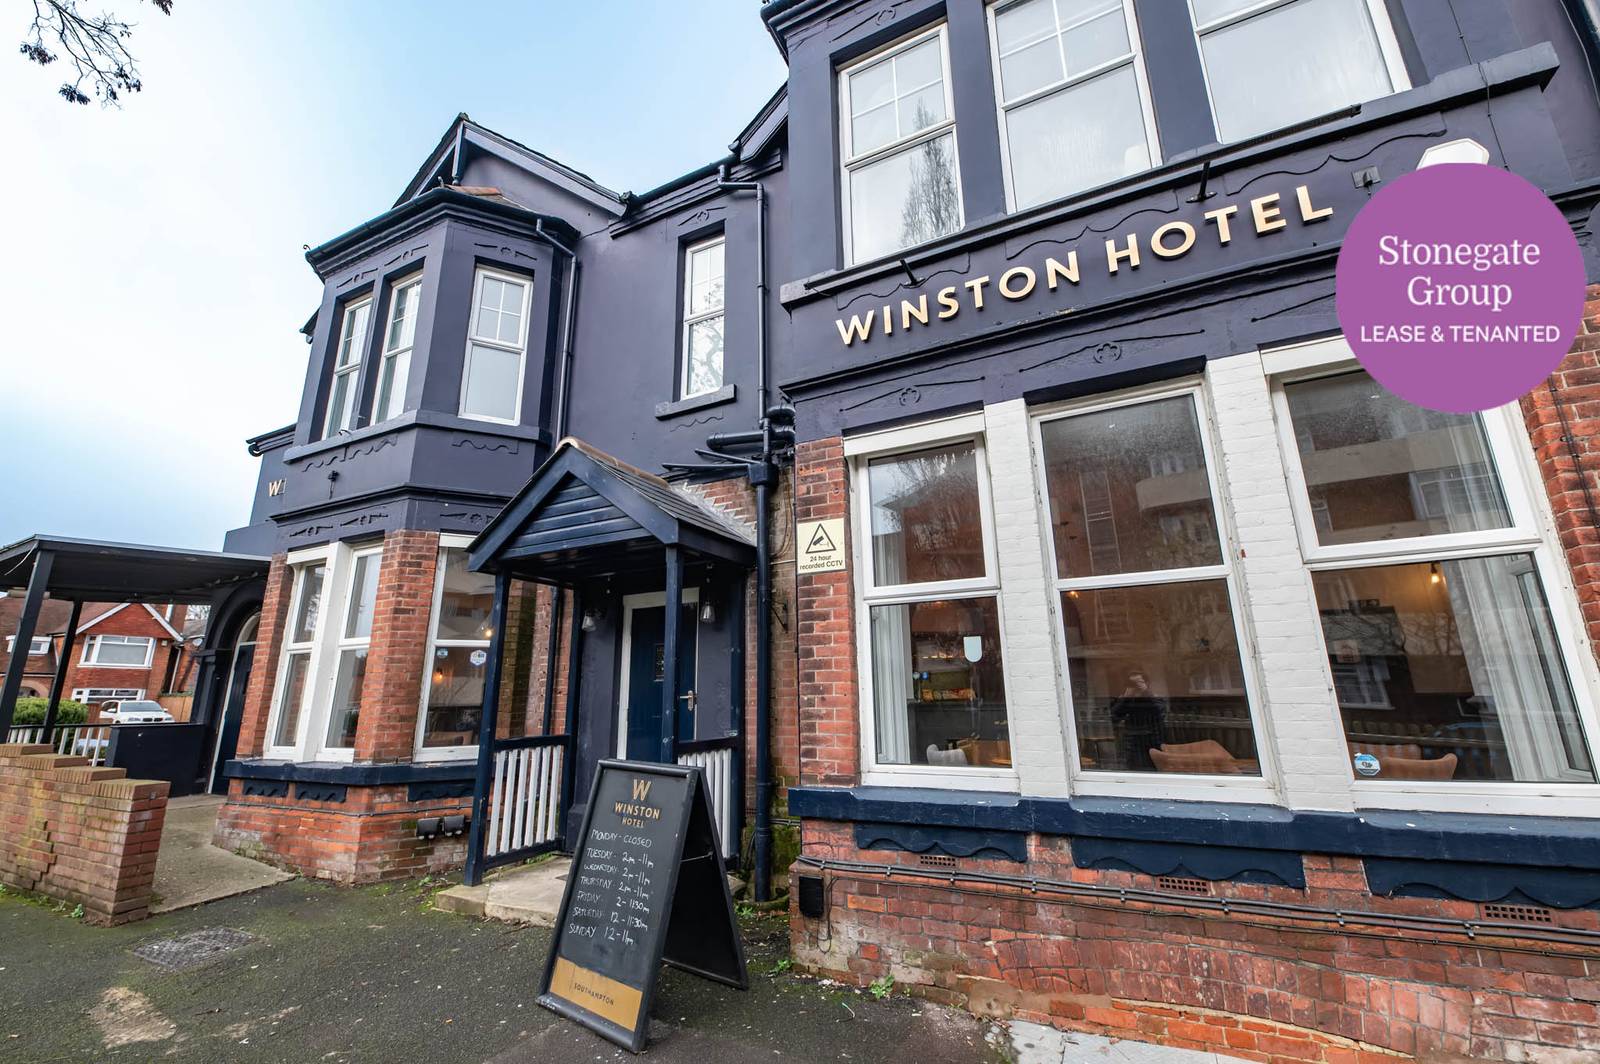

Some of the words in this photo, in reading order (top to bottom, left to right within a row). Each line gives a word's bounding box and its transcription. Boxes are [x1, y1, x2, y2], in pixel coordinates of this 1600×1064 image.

[835, 251, 1080, 345] WINSTON
[1105, 185, 1334, 274] HOTEL
[800, 562, 825, 570] recorded
[633, 779, 652, 801] W
[615, 802, 660, 820] WINSTON
[622, 817, 644, 828] HOTEL
[591, 829, 618, 841] MONDAY
[623, 835, 652, 848] CLOSED
[587, 848, 613, 859] TUESDAY
[574, 982, 615, 1006] SOUTHAMPTON
